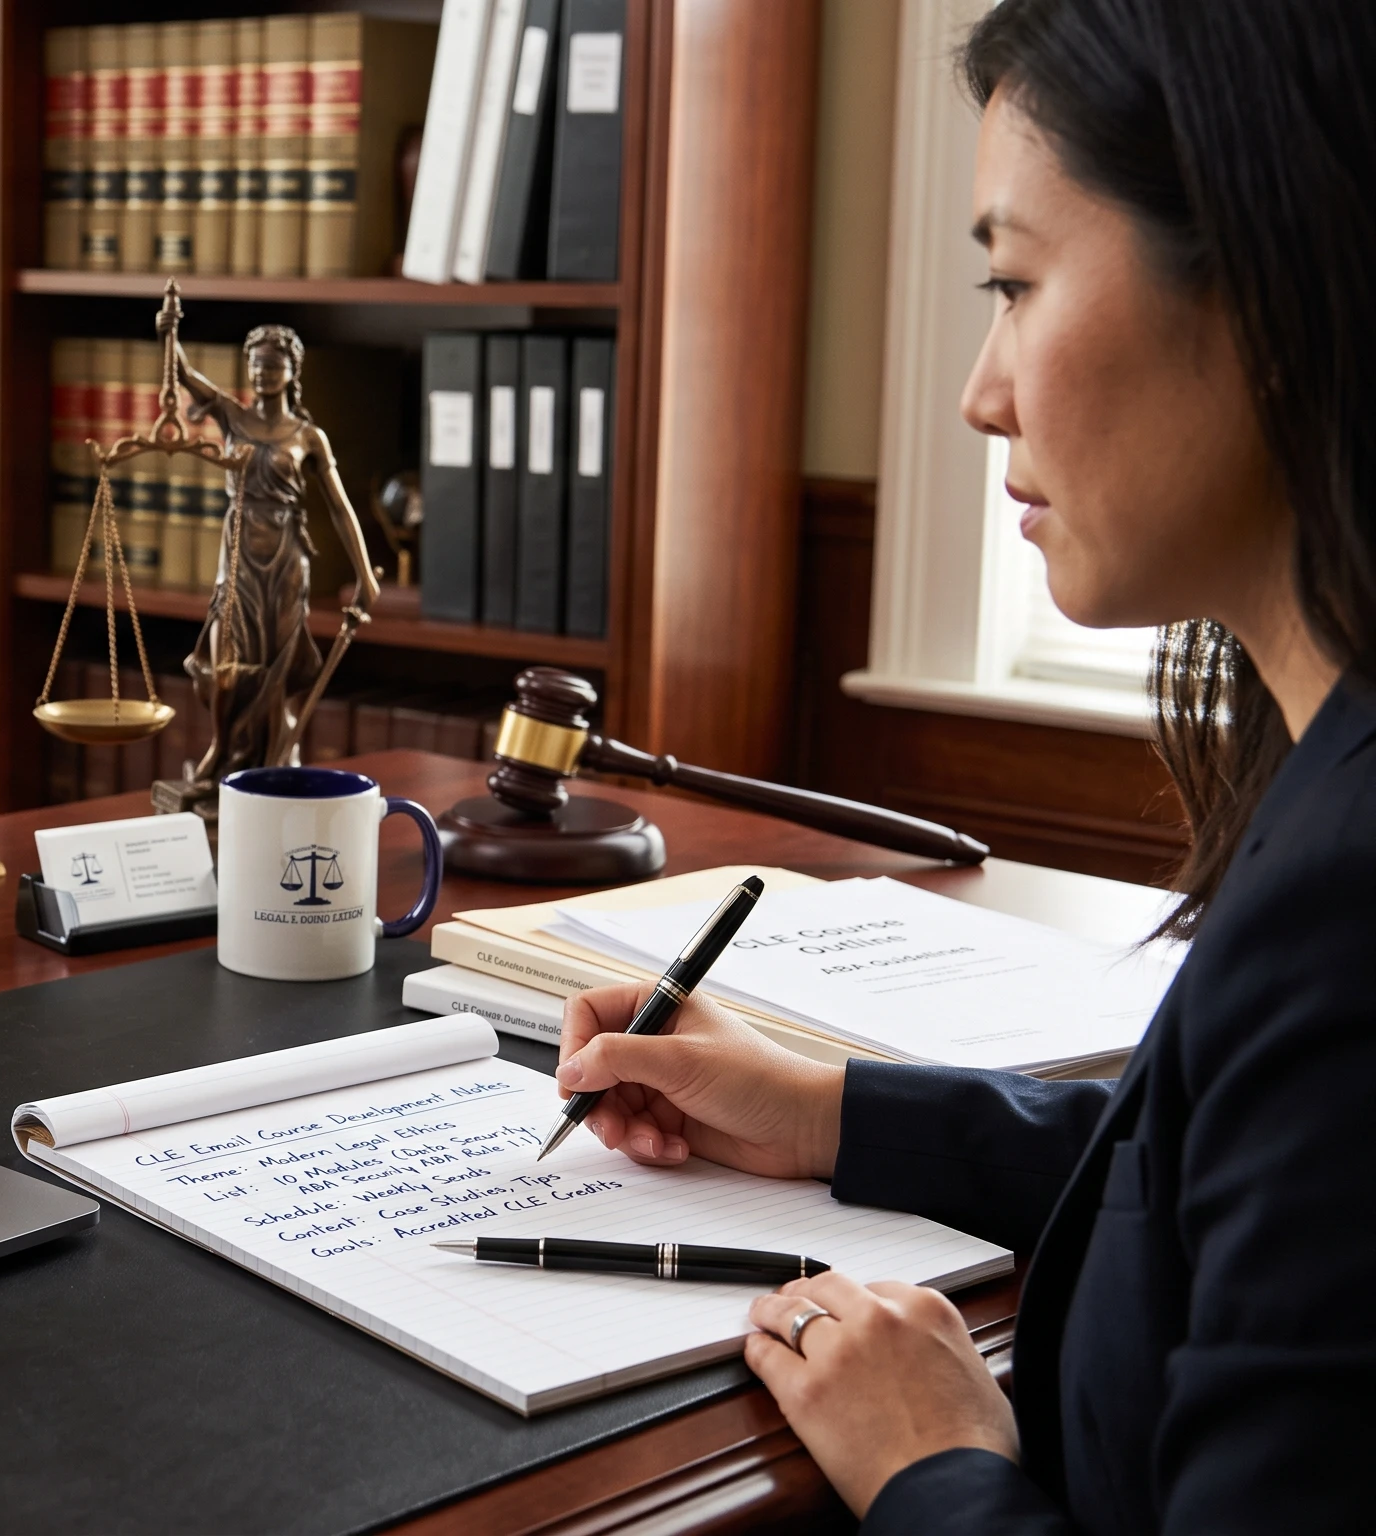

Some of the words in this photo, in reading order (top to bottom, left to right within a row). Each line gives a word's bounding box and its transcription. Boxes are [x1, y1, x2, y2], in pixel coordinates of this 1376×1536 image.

[254, 910, 289, 924] LEGAL
[732, 933, 799, 951] CLE
[797, 917, 907, 940] Course
[477, 951, 493, 964] CLE
[798, 934, 908, 956] Outline
[820, 963, 872, 976] ABA
[869, 944, 977, 968] Guidelines
[451, 1001, 470, 1013] CLE
[135, 1150, 185, 1167] CLE
[189, 1134, 252, 1156] Email
[257, 1121, 323, 1141] Course
[325, 1094, 449, 1126] Development
[450, 1079, 511, 1098] Notes
[166, 1166, 248, 1188] Theme:
[258, 1148, 335, 1168] Modern
[336, 1134, 390, 1153] Legal
[393, 1120, 457, 1139] Ethics
[203, 1184, 259, 1203] List:
[272, 1173, 298, 1187] 10
[303, 1156, 384, 1182] Modules
[391, 1142, 447, 1160] (Data
[298, 1178, 339, 1195] ABA
[341, 1162, 420, 1185] Security
[420, 1154, 458, 1168] ABA
[461, 1144, 505, 1158] Rule
[243, 1198, 347, 1228] Schedule:
[352, 1180, 434, 1203] Weekly
[431, 1166, 492, 1186] Sends
[278, 1214, 366, 1242] Content:
[378, 1204, 429, 1220] Case
[429, 1185, 516, 1209] Studies,
[510, 1171, 562, 1189] Tips
[392, 1206, 499, 1239] Accredited
[503, 1195, 547, 1212] CLE
[550, 1179, 623, 1201] Credits
